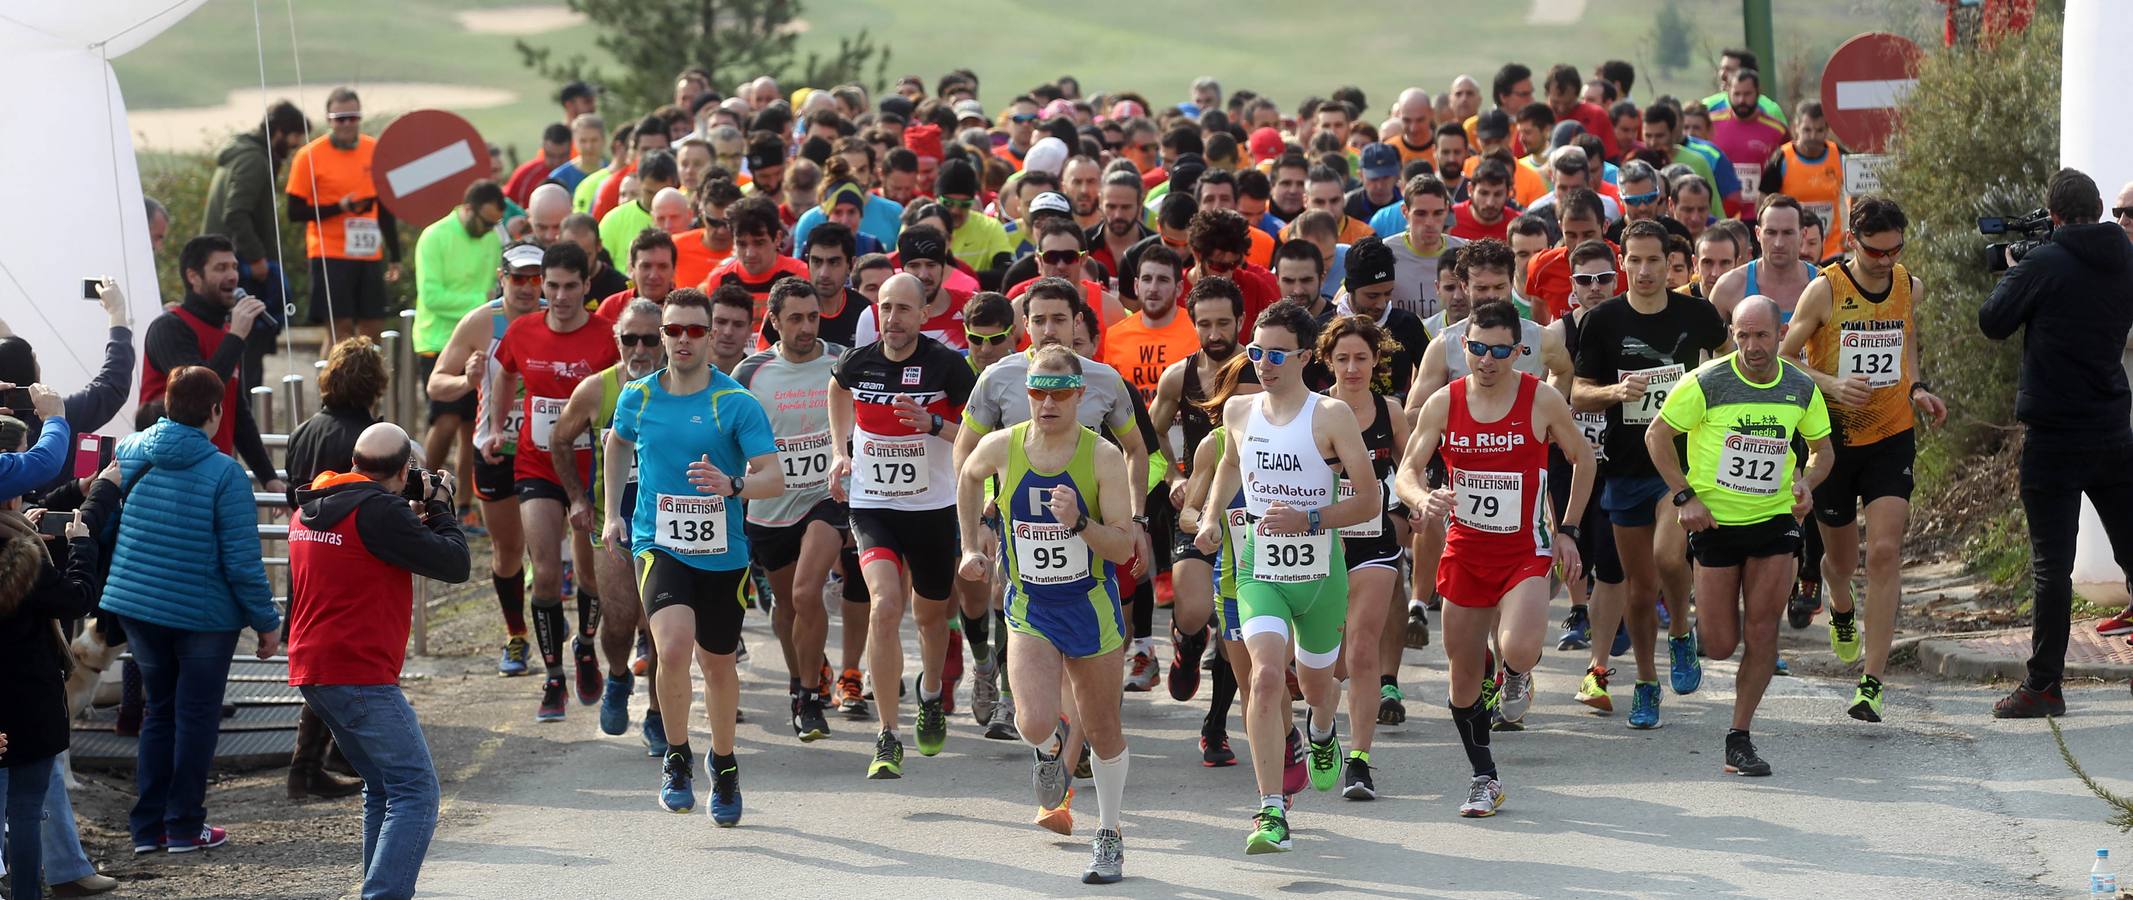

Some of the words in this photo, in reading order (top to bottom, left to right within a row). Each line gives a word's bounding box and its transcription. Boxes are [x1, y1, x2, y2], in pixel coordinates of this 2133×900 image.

[1860, 337, 1902, 348] ATLETISMO
[1139, 345, 1167, 364] WE
[1851, 353, 1893, 374] 132
[1032, 377, 1060, 387] NIKE
[1133, 366, 1167, 385] RU
[788, 434, 833, 453] ATLETISMO
[1449, 431, 1469, 447] La
[1476, 431, 1525, 452] Rioja
[1743, 442, 1789, 455] ATLETISMO
[877, 447, 925, 457] ATLETISMO
[1256, 451, 1303, 472] TEJADA
[784, 453, 828, 477] 170
[872, 463, 917, 484] 179
[1729, 456, 1776, 481] 312
[864, 487, 929, 497] www.fratletismo.com
[1252, 480, 1327, 497] CataNatura
[1468, 479, 1519, 490] ATLETISMO
[675, 502, 725, 514] ATLETISMO
[1468, 494, 1500, 518] 79
[668, 520, 715, 541] 138
[1033, 546, 1068, 570] 95
[1266, 543, 1315, 567] 303
[1020, 569, 1088, 583] www.fratletismo.com
[1255, 573, 1327, 582] www.fratletismo.com
